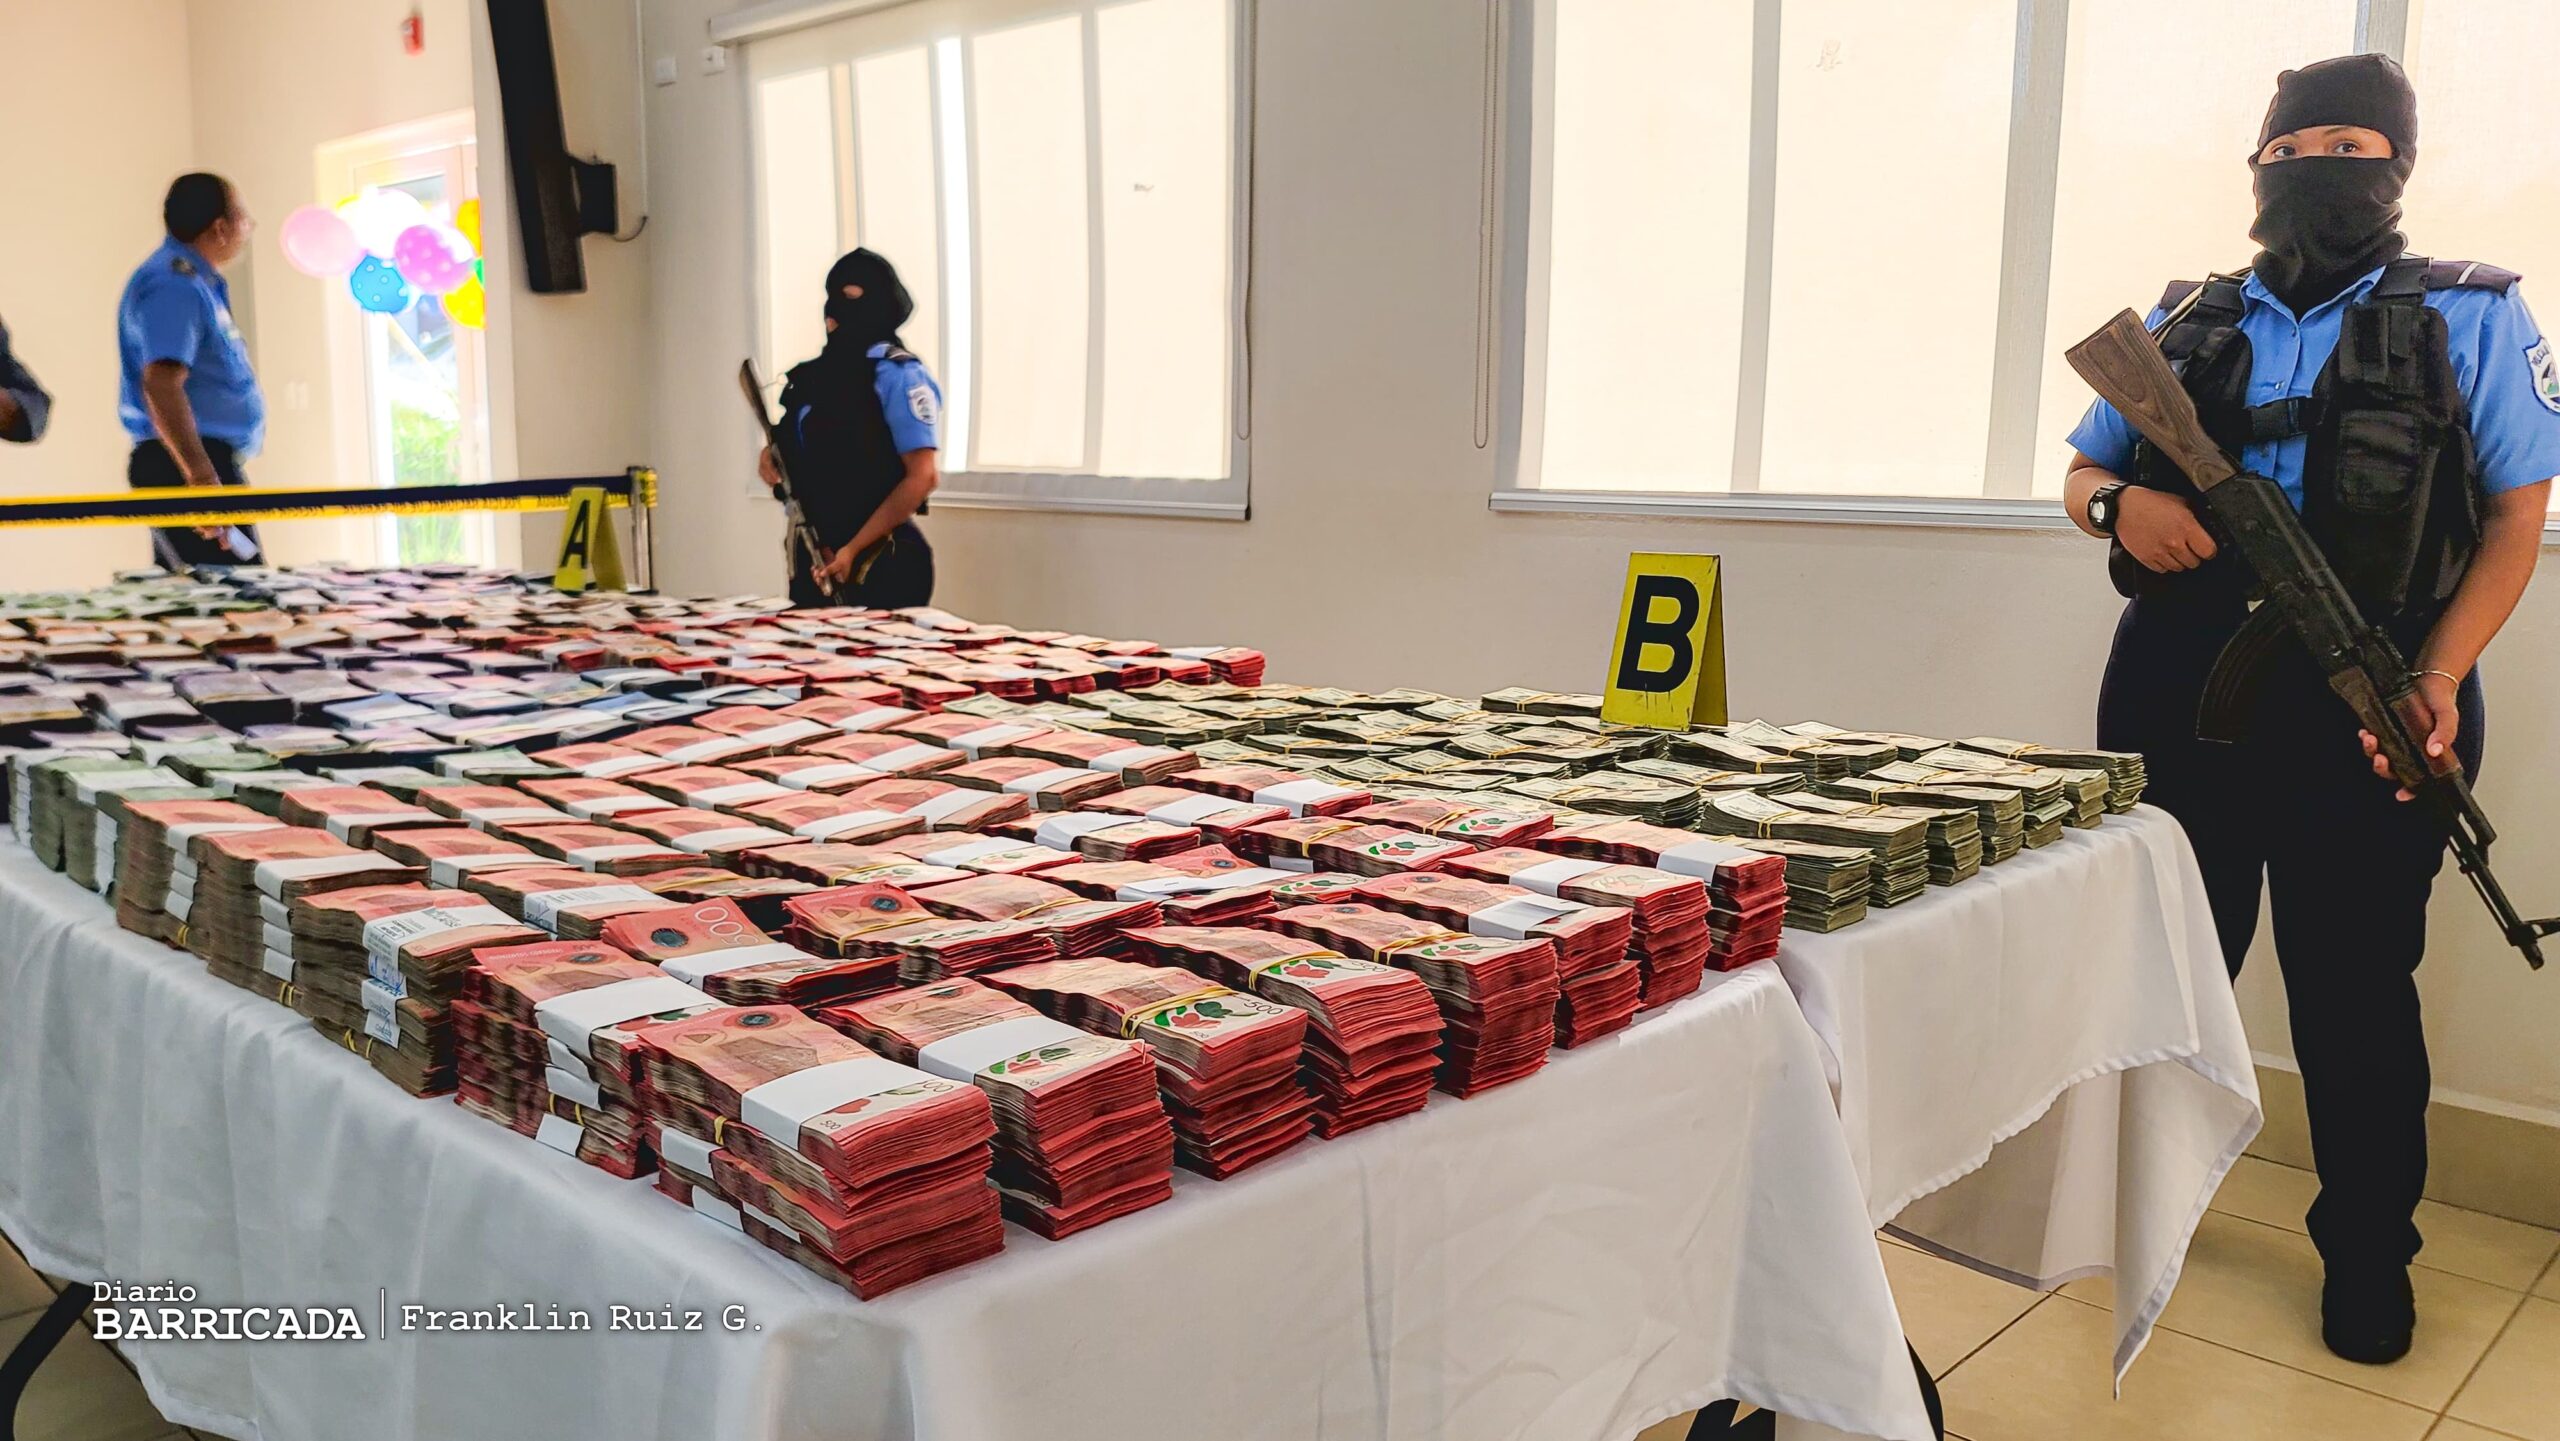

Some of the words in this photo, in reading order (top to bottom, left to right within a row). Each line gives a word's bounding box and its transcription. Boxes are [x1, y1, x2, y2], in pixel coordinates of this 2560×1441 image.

[560, 499, 589, 569] A
[1616, 574, 1700, 693] B
[1243, 1000, 1283, 1015] 500
[819, 1119, 842, 1130] 500
